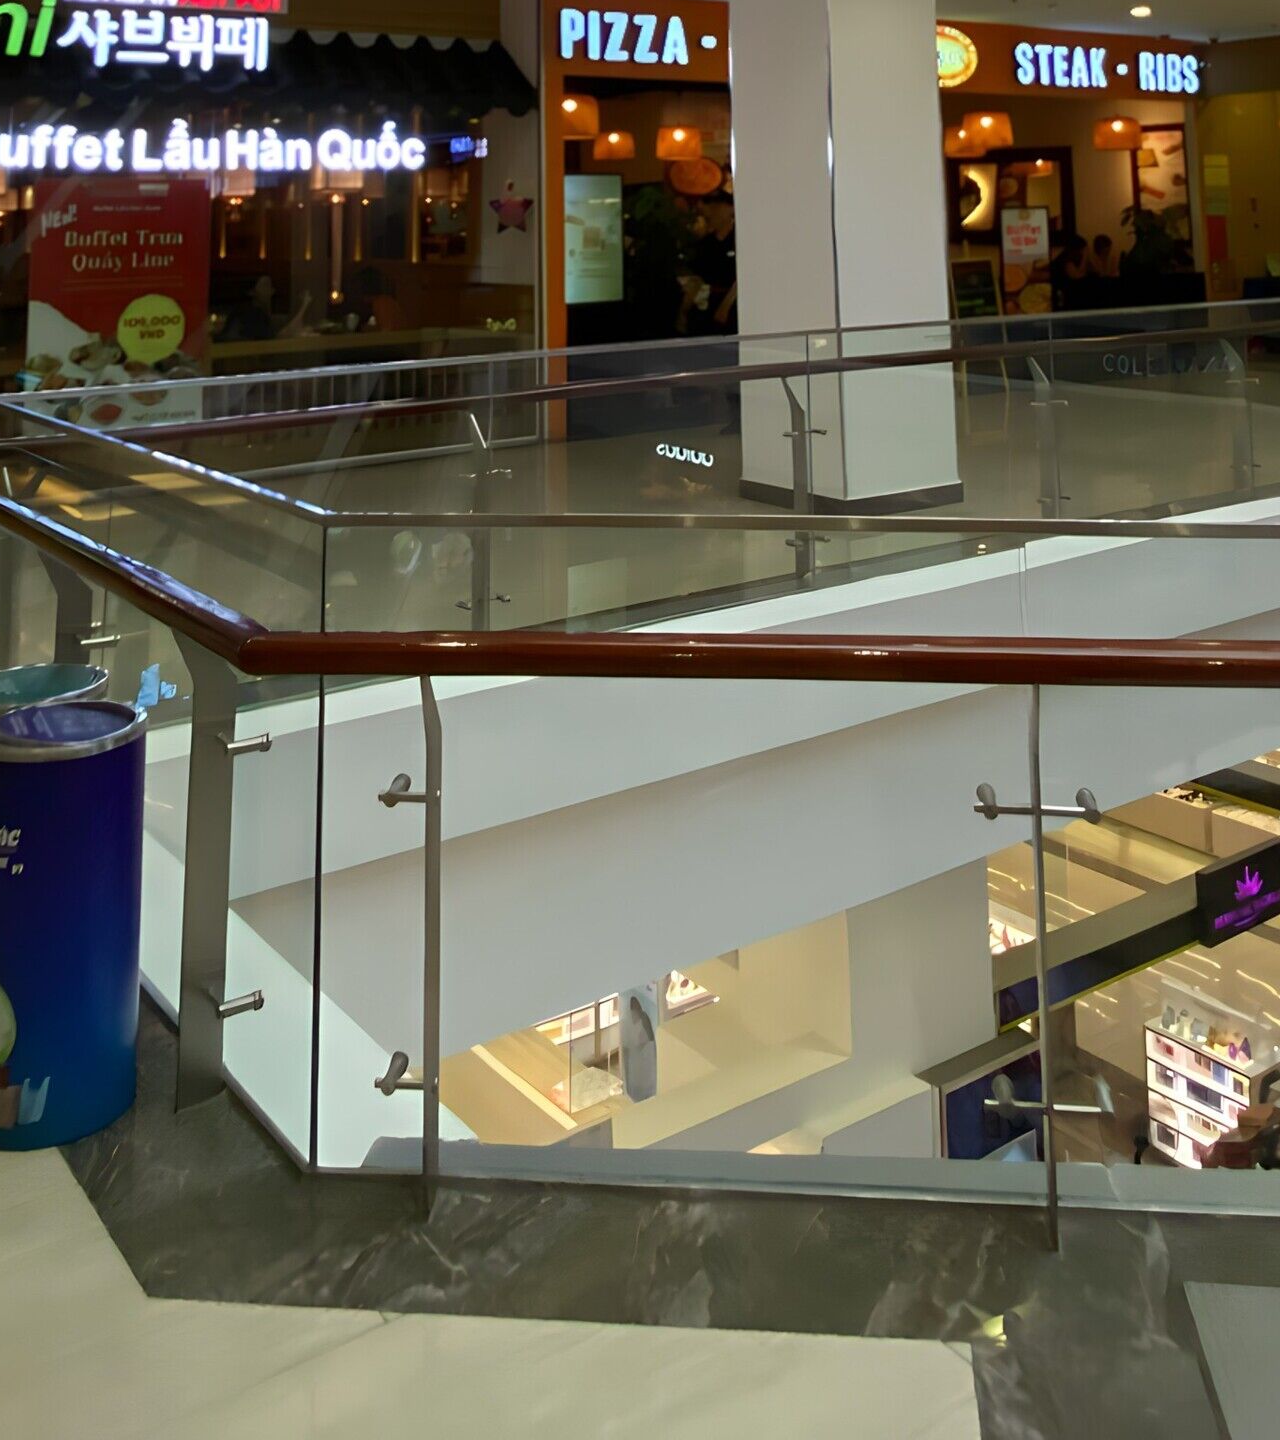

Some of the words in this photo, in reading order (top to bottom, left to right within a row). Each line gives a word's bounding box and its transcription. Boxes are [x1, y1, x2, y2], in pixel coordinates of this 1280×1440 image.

[56, 9, 269, 71] 샤브뷔페
[560, 8, 689, 65] PIZZA
[1014, 42, 1108, 89] STEAK
[1138, 51, 1201, 94] RIBS
[131, 117, 220, 172] Lẩu
[225, 126, 313, 171] Hàn
[317, 120, 426, 171] Quốc
